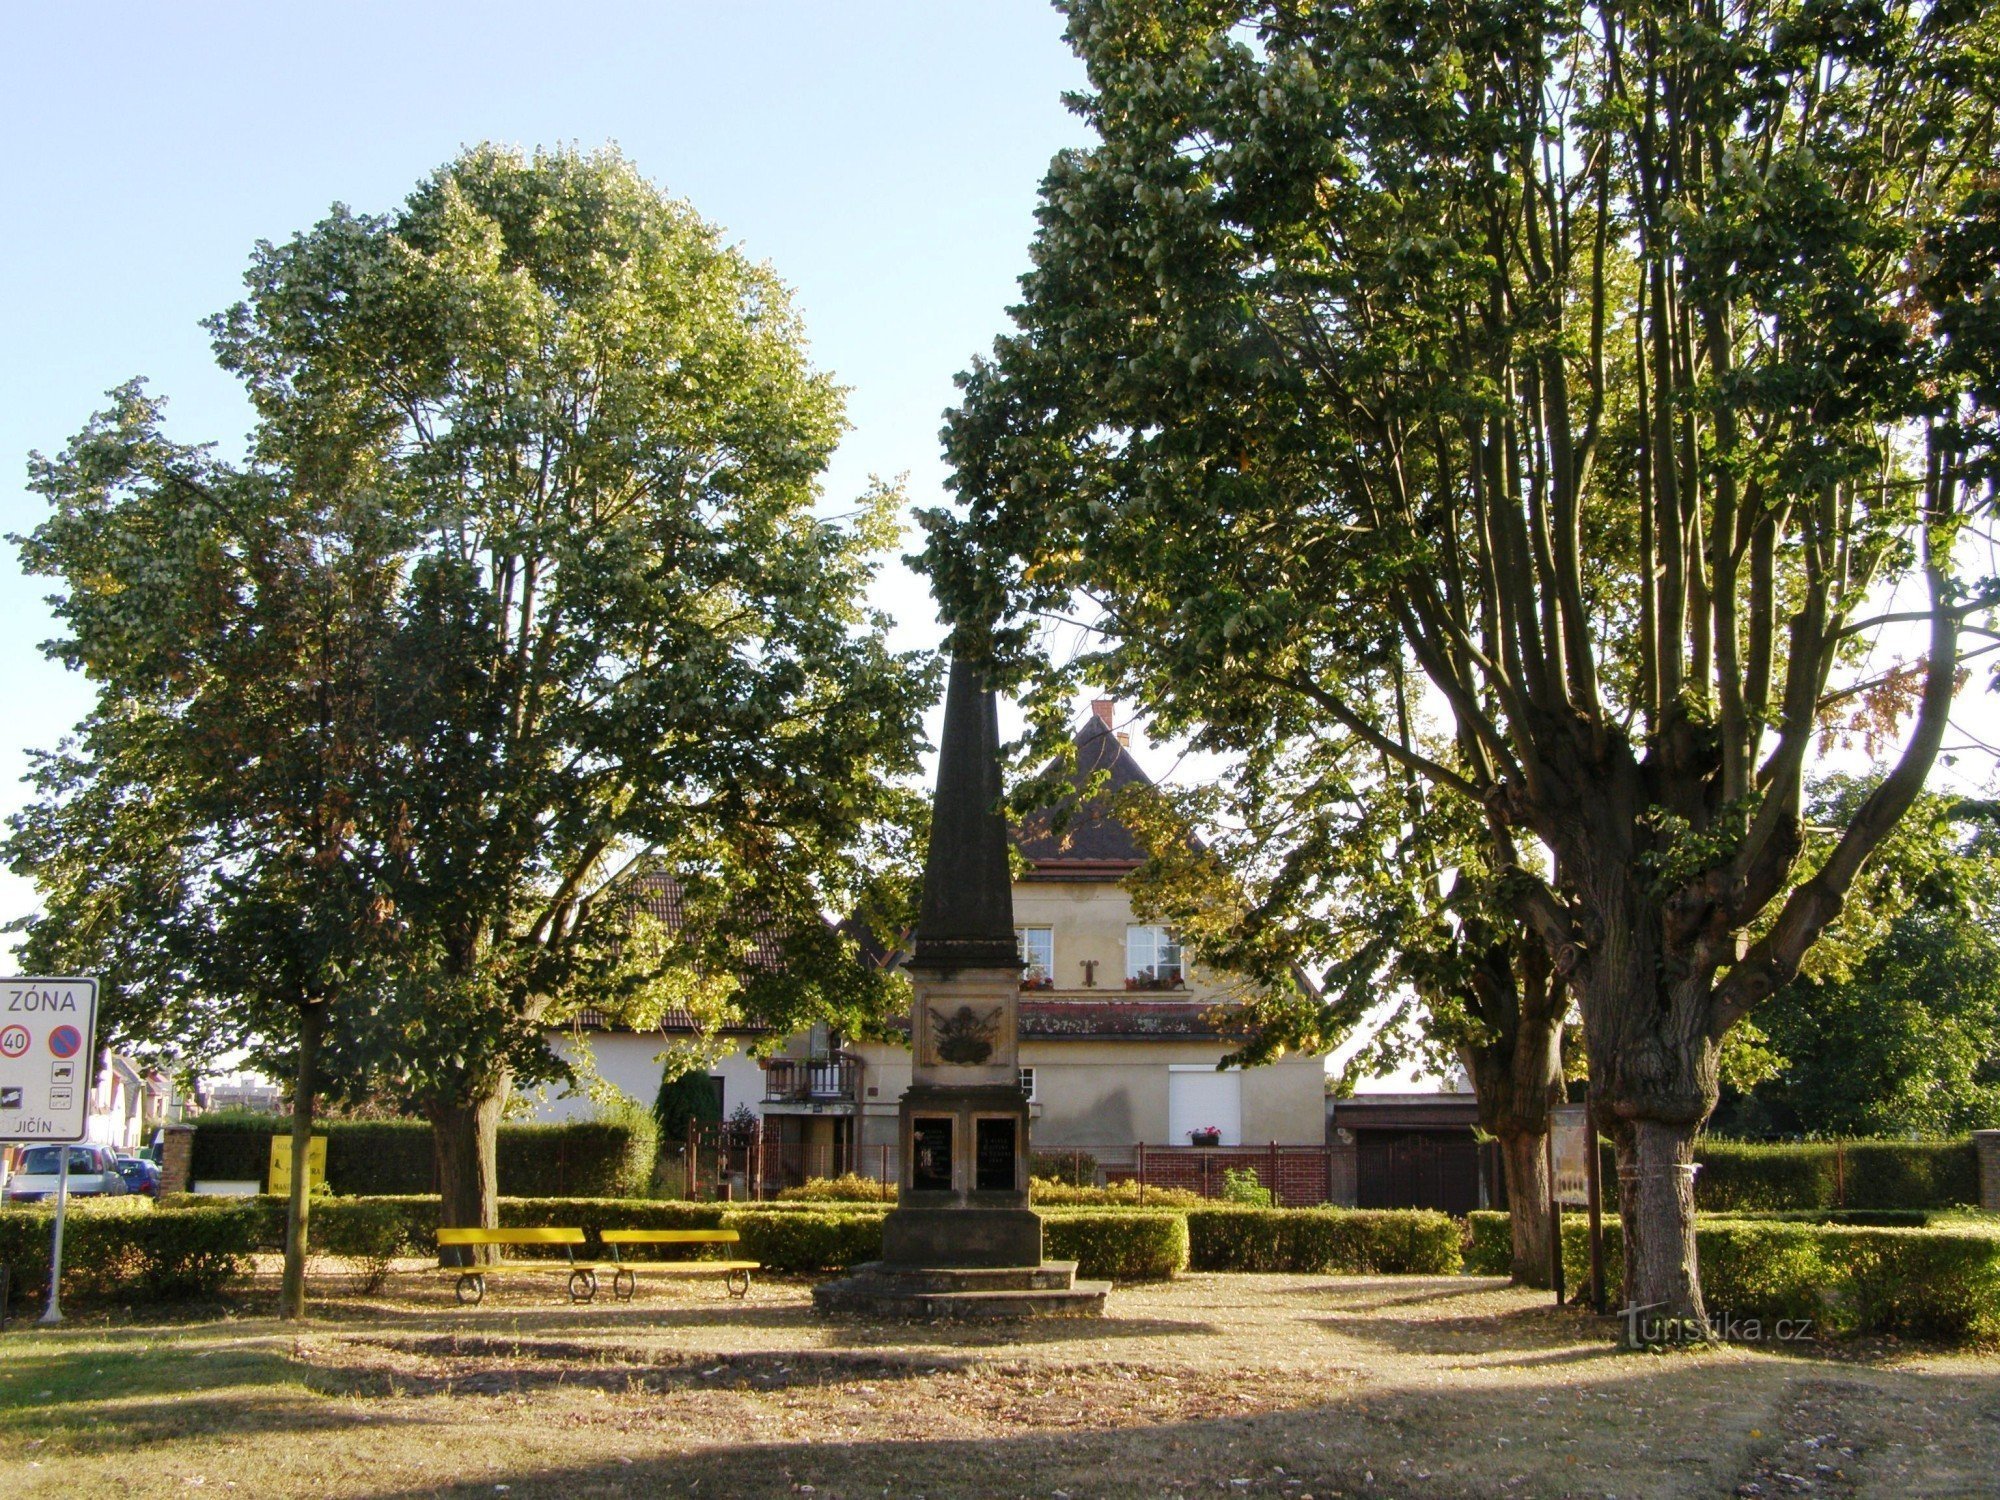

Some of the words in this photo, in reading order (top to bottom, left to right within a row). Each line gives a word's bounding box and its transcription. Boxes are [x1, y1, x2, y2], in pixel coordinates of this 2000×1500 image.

[8, 984, 76, 1012] ZÓNA
[4, 1033, 25, 1049] 40
[15, 1117, 52, 1133] JIČÍN
